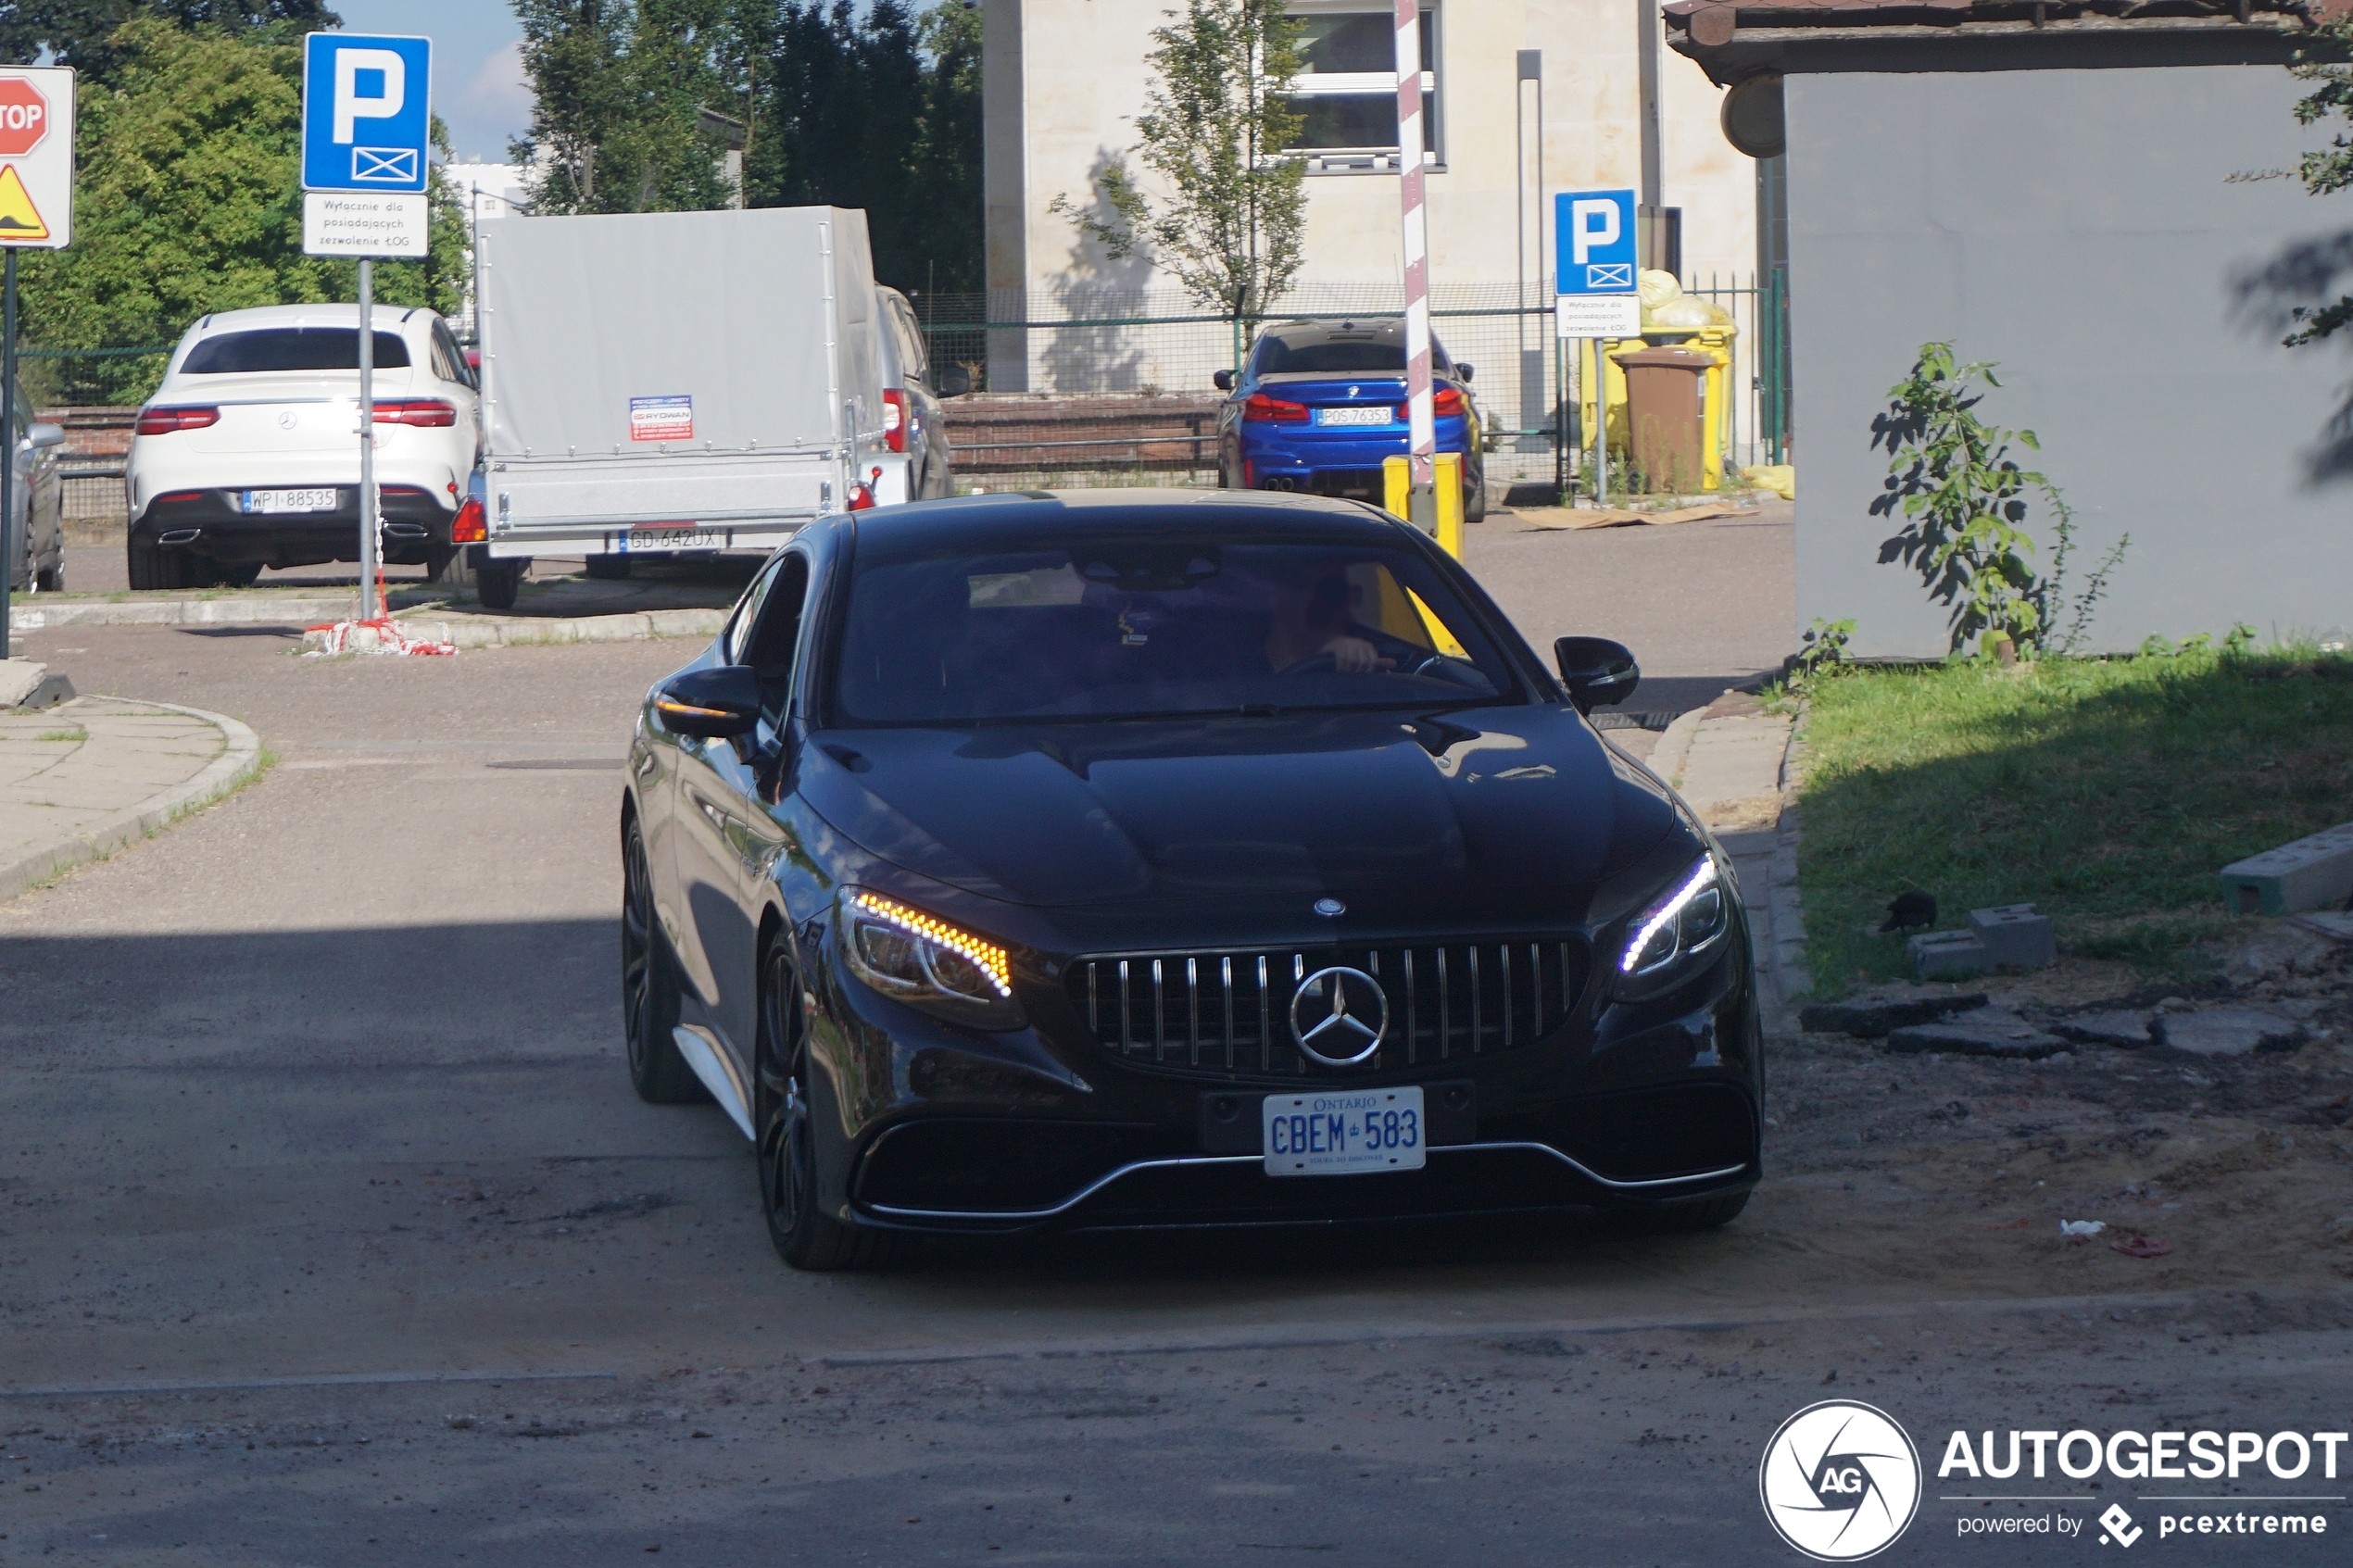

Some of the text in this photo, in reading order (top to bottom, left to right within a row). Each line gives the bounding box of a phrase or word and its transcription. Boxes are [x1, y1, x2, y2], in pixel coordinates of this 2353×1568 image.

[333, 48, 405, 144] P
[324, 200, 403, 213] Wyłącznie dla
[1573, 198, 1620, 264] P
[320, 235, 409, 246] zezwolenie ŁOG
[1325, 408, 1390, 422] POS 76353
[252, 491, 334, 508] WPI 88535
[631, 528, 716, 548] GD 642UX
[1314, 1097, 1377, 1111] ONTARIO
[1272, 1109, 1417, 1154] CBEM 583
